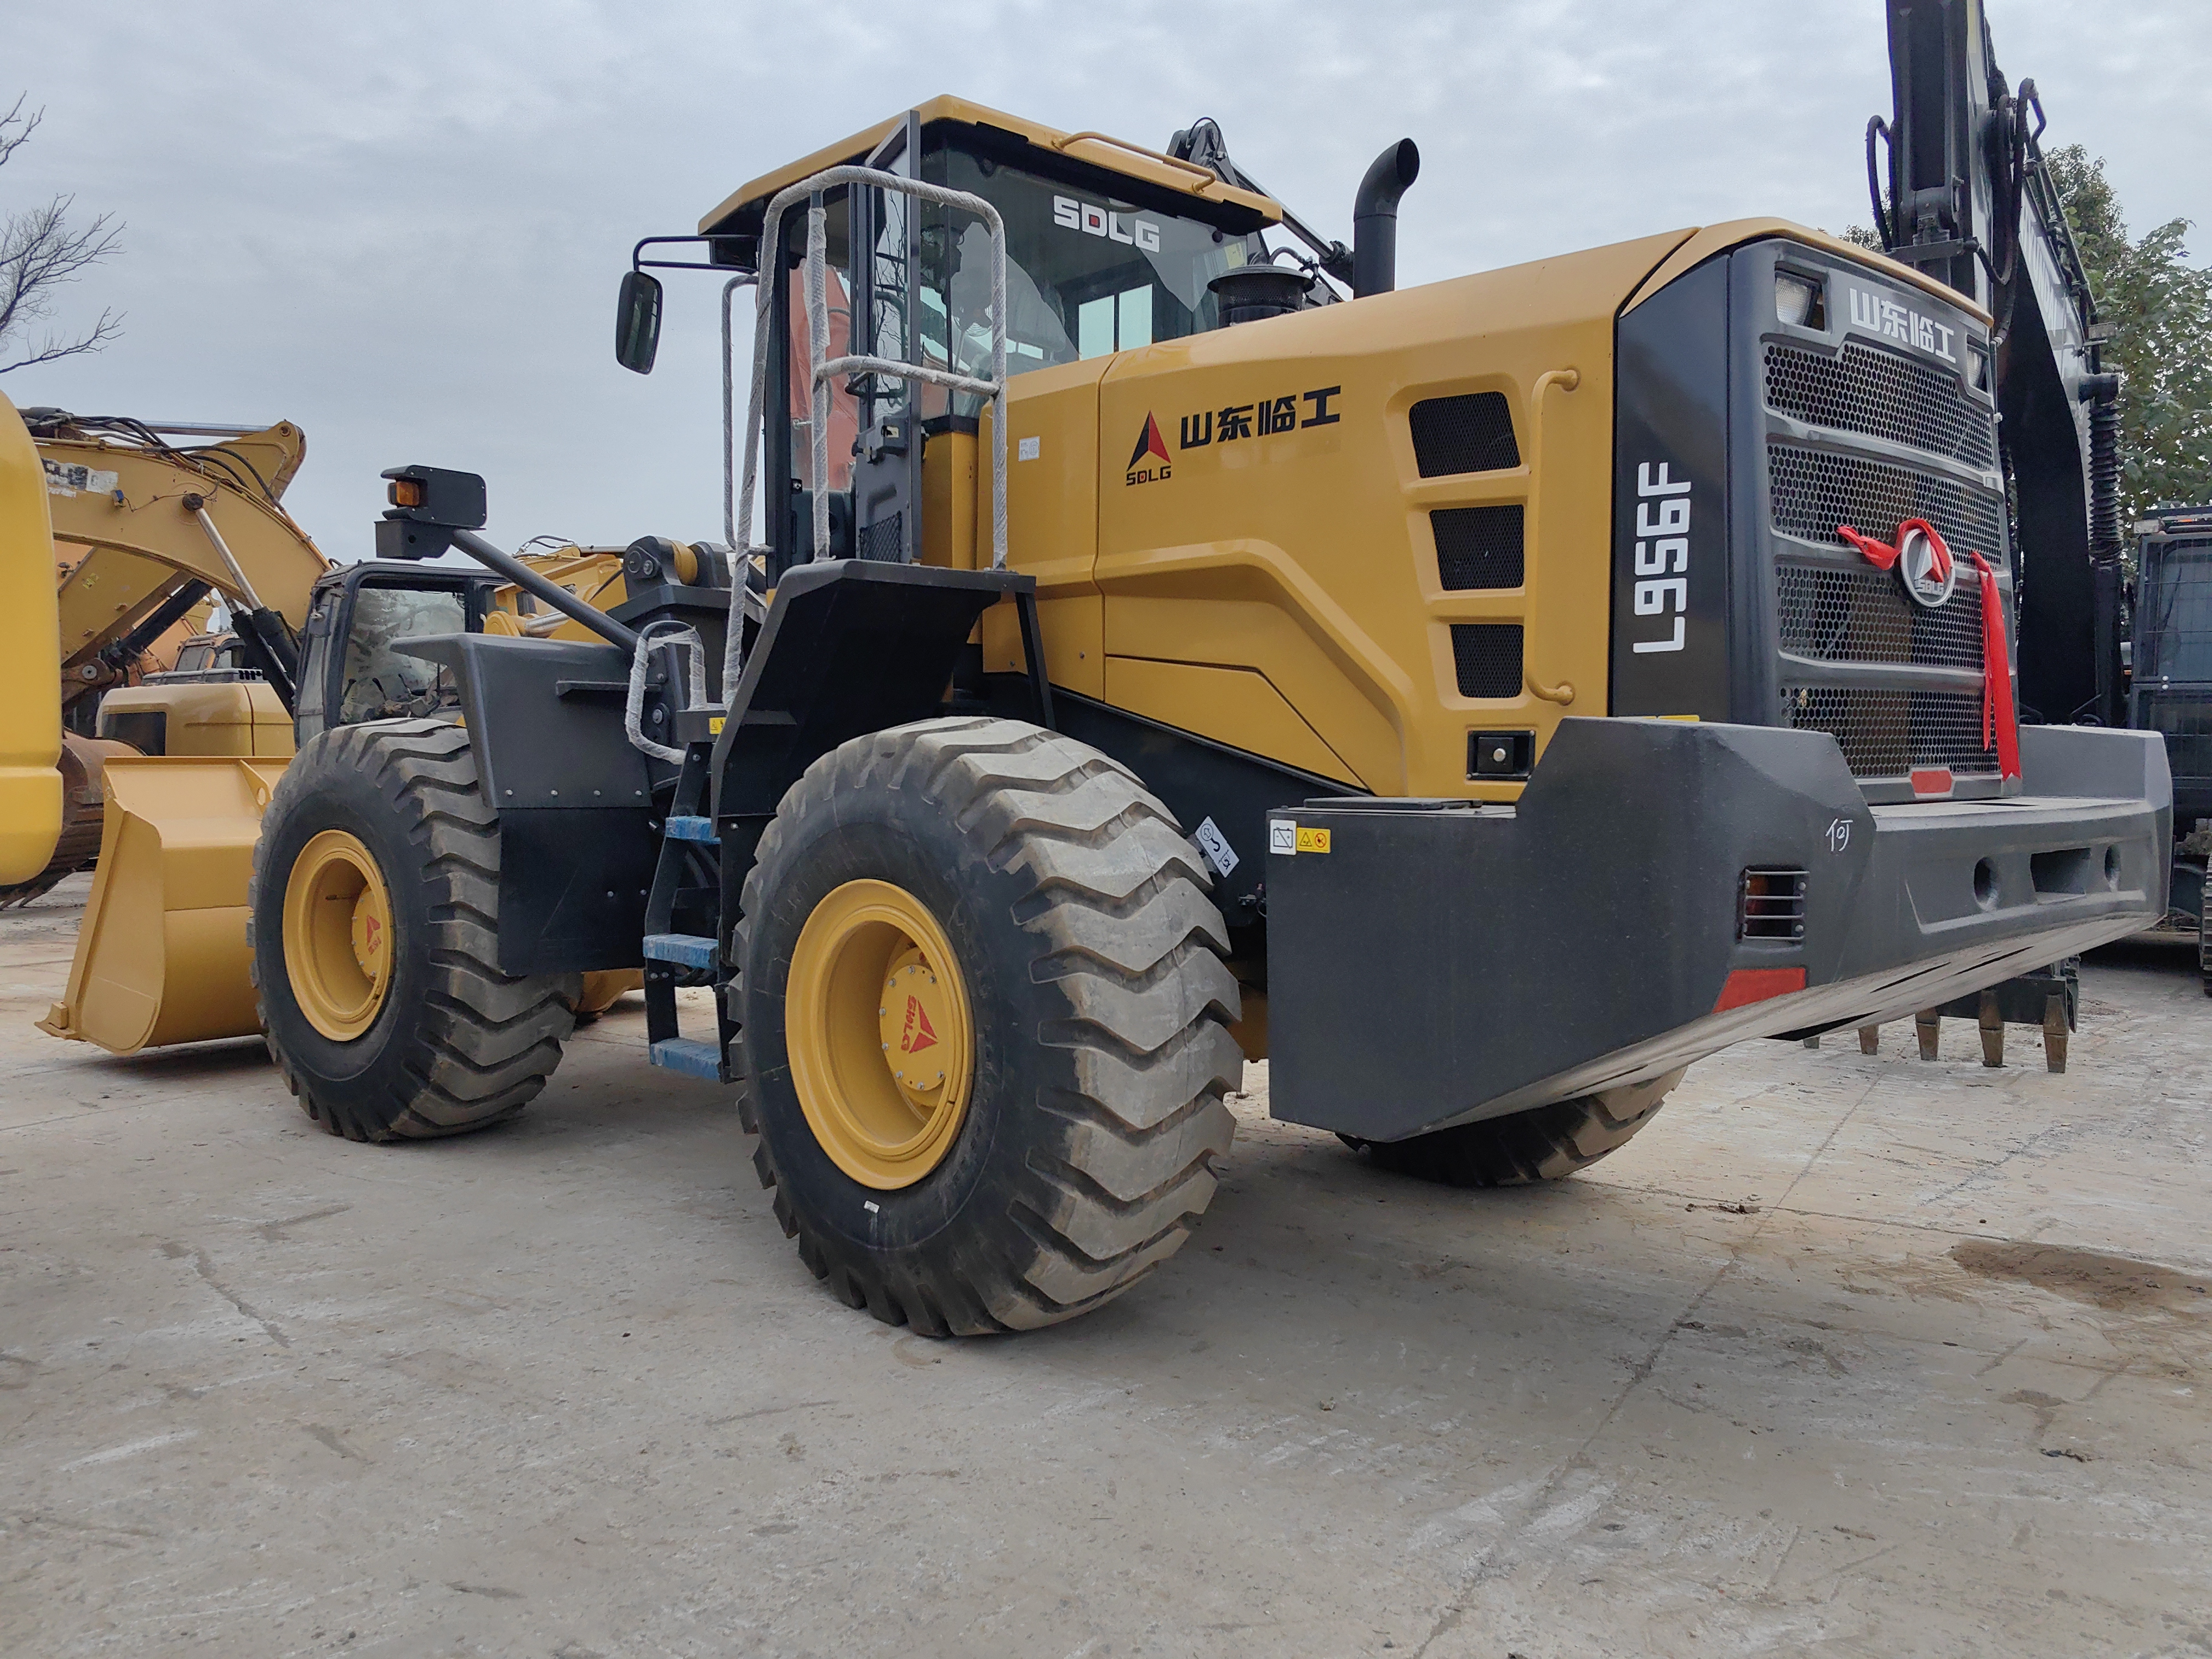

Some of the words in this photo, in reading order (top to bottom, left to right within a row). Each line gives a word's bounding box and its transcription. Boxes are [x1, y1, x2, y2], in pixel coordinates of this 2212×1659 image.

[1053, 195, 1160, 253] SDLG
[1849, 288, 1957, 364] 山东临工
[1180, 385, 1342, 450] 山东临工
[1126, 465, 1171, 486] SDLG
[1632, 462, 1692, 654] L956F
